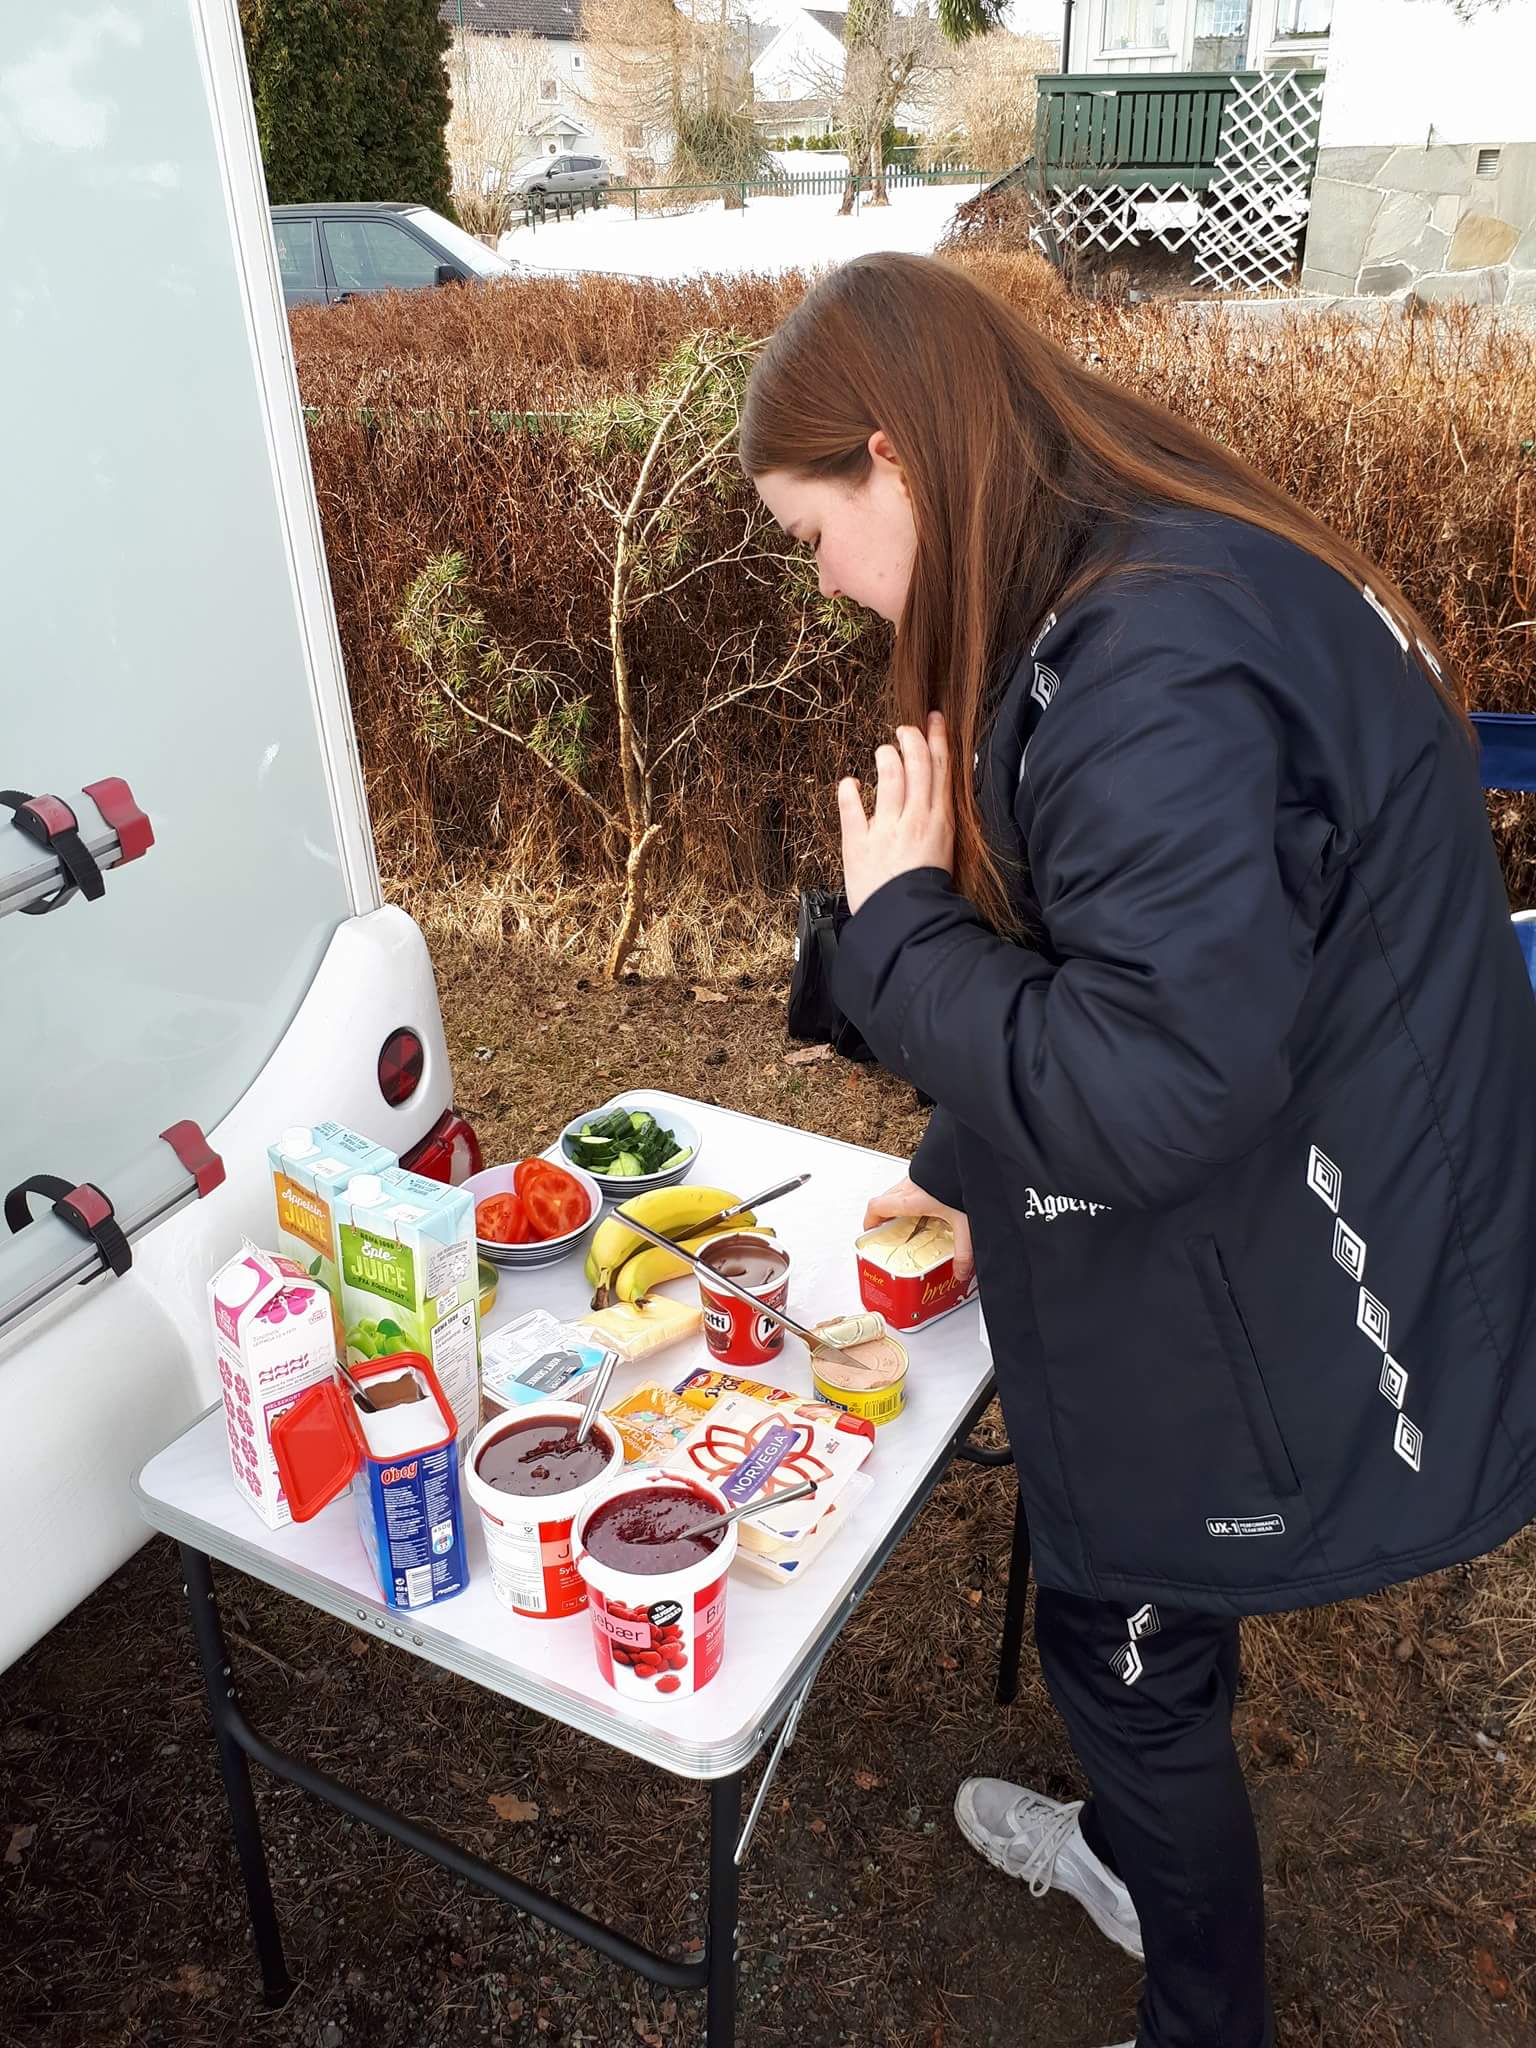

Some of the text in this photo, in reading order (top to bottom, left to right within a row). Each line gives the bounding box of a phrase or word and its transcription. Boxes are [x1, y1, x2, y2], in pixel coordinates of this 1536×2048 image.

[285, 1204, 328, 1243] JUICE
[351, 1255, 408, 1292] JUICE
[730, 1433, 789, 1497] NORVEGIA
[1209, 1522, 1239, 1534] UX-1
